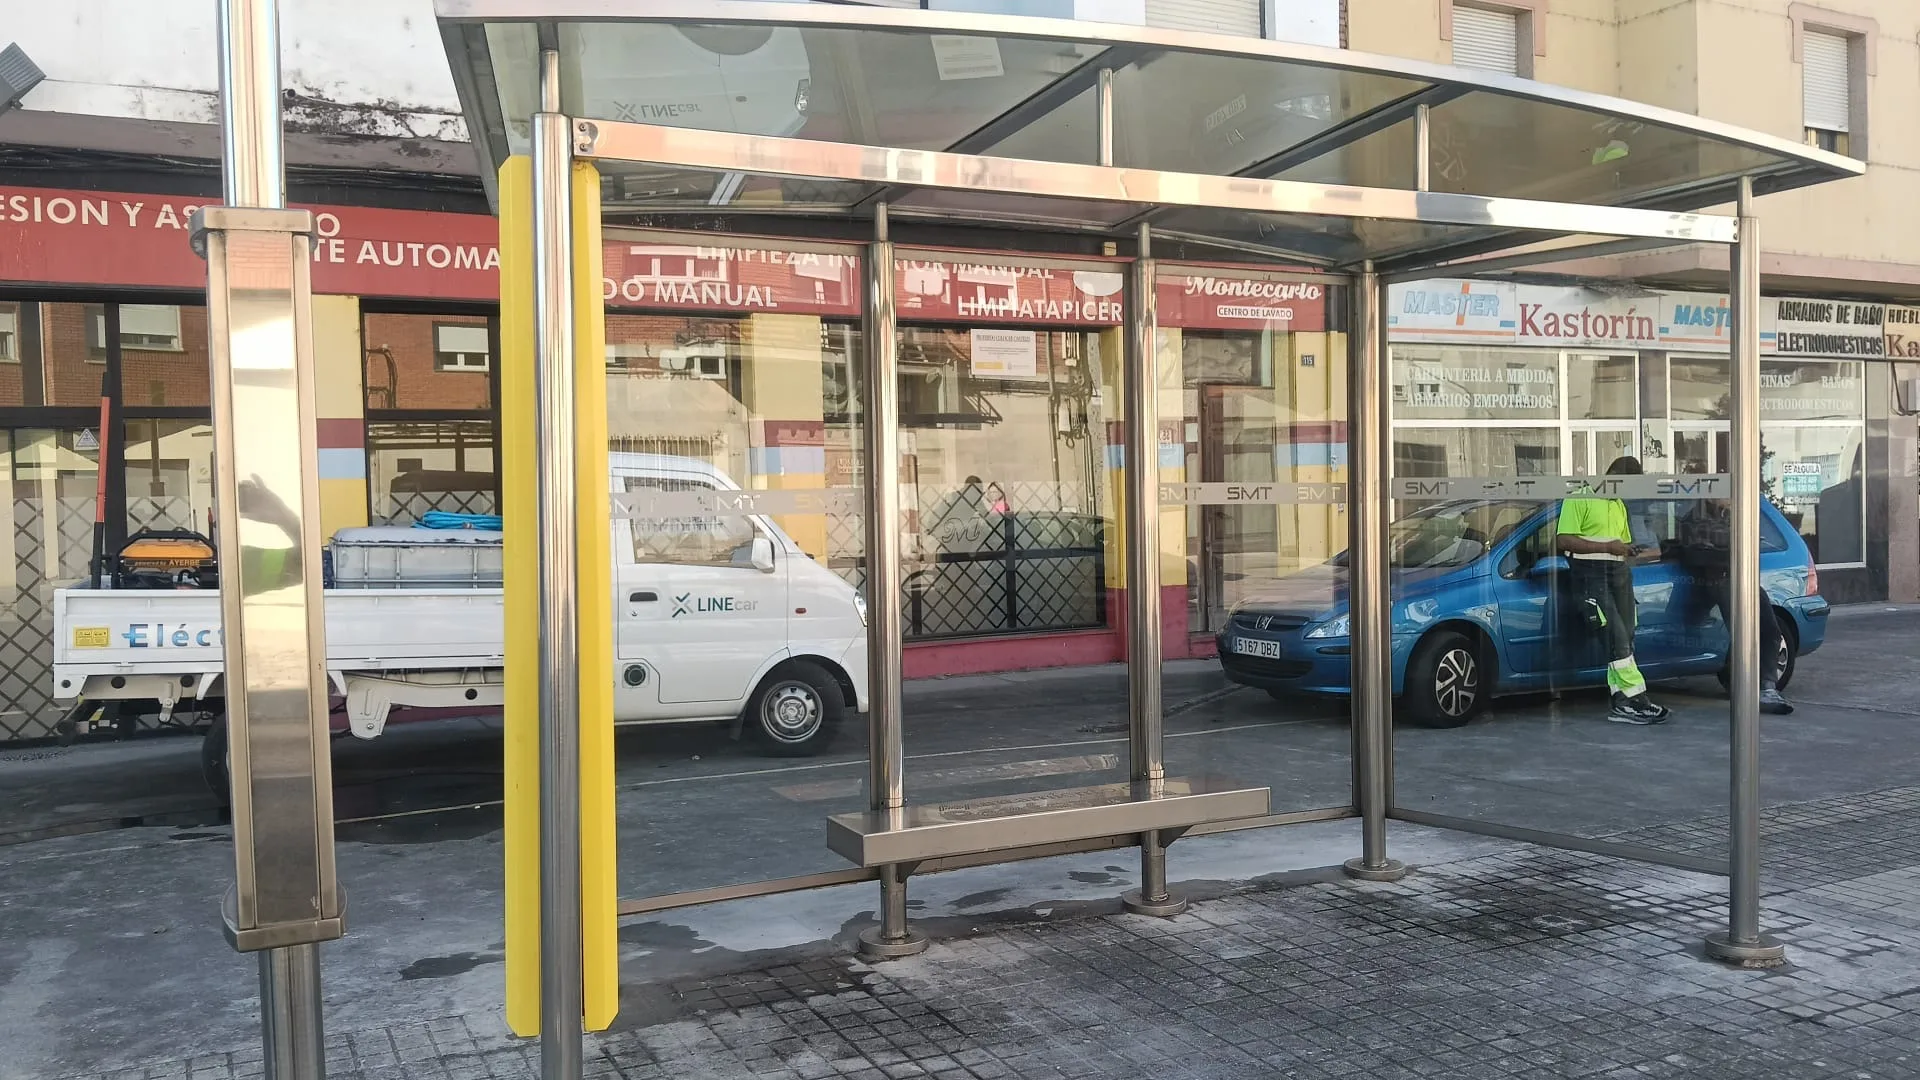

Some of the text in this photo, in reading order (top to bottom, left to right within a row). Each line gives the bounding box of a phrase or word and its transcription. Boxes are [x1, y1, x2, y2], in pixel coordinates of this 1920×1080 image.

[0, 195, 109, 226] SION
[121, 202, 144, 227] Y
[654, 280, 779, 308] MANUAL
[1185, 275, 1321, 300] Montecarlo
[957, 295, 1124, 322] LIMPIATAPICER
[1218, 307, 1292, 318] CENTRO DE LAVADO
[1403, 290, 1500, 318] MASTER
[1777, 301, 1883, 326] ARMARIOS DE BAÑO
[1519, 303, 1656, 341] Kastorín
[1495, 368, 1504, 381] A
[1507, 368, 1554, 384] MEDIDA
[1406, 393, 1553, 409] ARMARIOS EMPOTRADOS
[1784, 465, 1820, 473] SE ALQUILA
[1227, 486, 1272, 500] SMT
[1298, 486, 1341, 500] SMT
[1405, 481, 1452, 496] SMT
[1565, 479, 1624, 495] SMT
[1656, 478, 1719, 494] SMT
[697, 596, 758, 612] LINEcar
[129, 623, 225, 648] Eléc
[1238, 639, 1278, 657] 5167 DBZ
